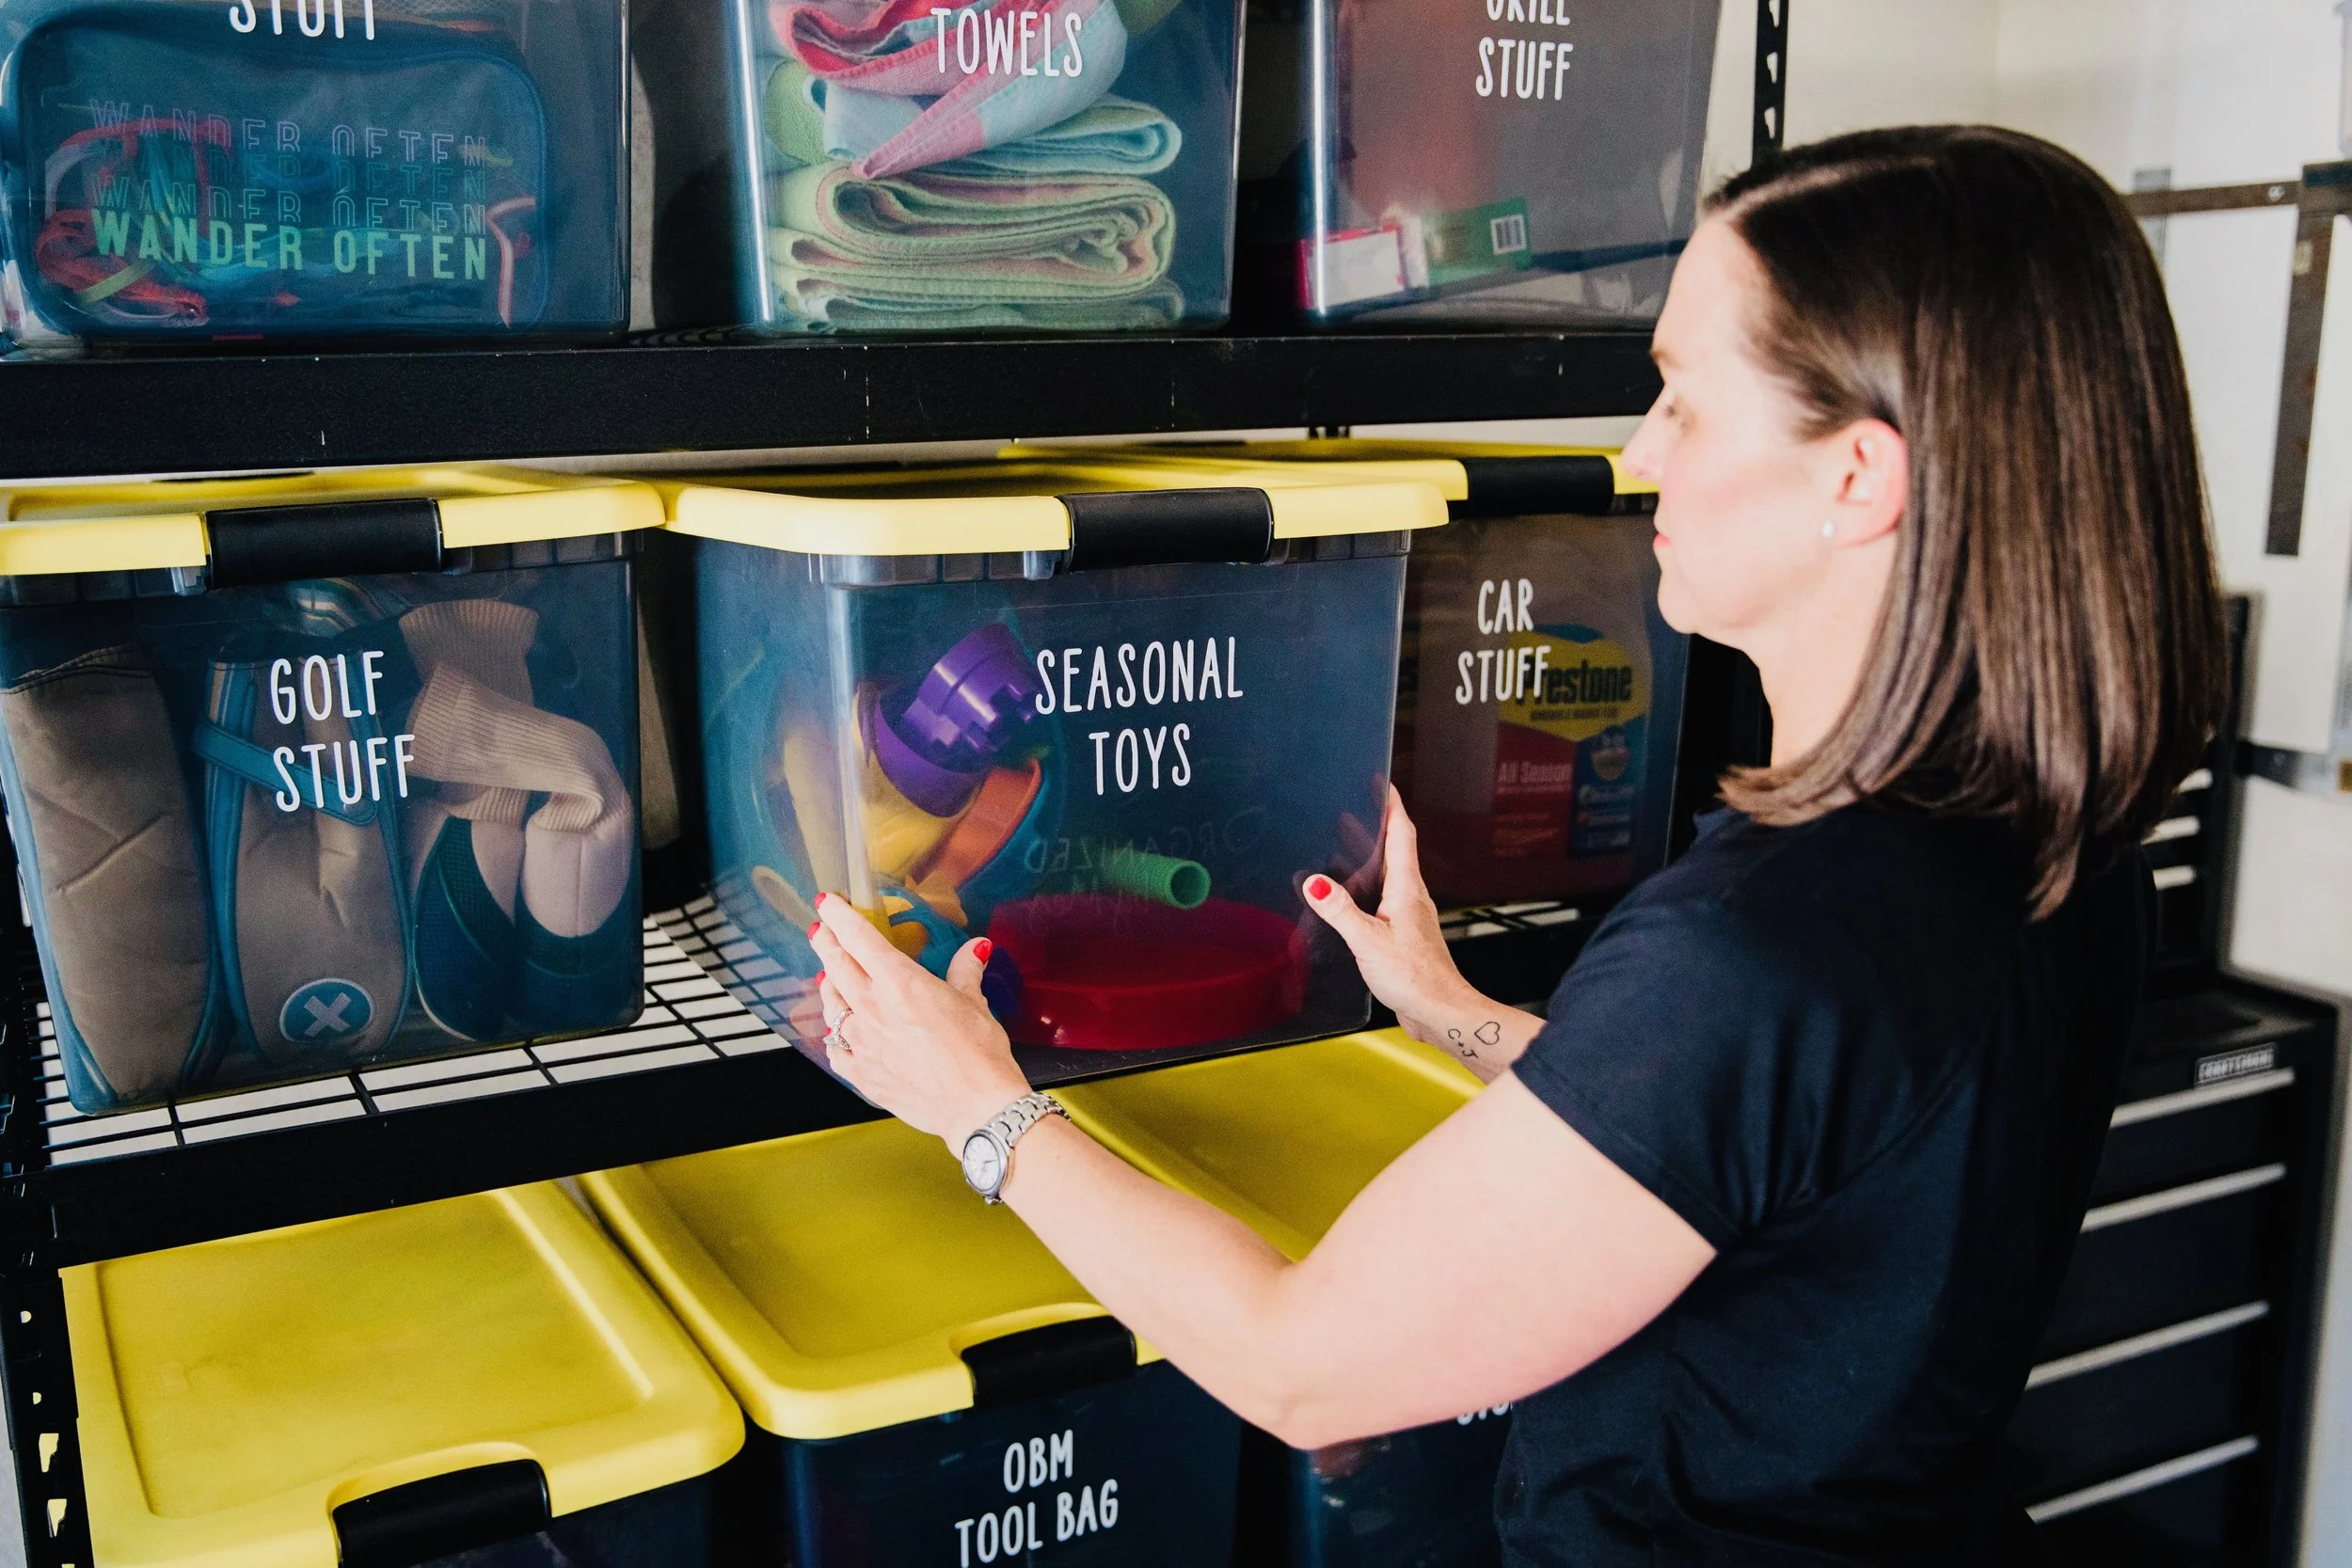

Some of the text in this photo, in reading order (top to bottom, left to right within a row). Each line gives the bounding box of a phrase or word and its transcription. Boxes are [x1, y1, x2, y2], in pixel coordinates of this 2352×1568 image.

[930, 8, 1083, 78] TOWELS
[1475, 36, 1574, 101] STUFF
[91, 209, 487, 280] WANDER OFTEN
[1477, 578, 1534, 635] CAR
[270, 650, 384, 724] GOLF
[1035, 636, 1244, 716] SEASONAL
[1455, 645, 1551, 705] STUFF
[273, 734, 416, 813] STUFF
[1088, 722, 1192, 796] TOYS
[1003, 1429, 1073, 1494] OBM
[954, 1479, 1120, 1568] TOOL BAG
